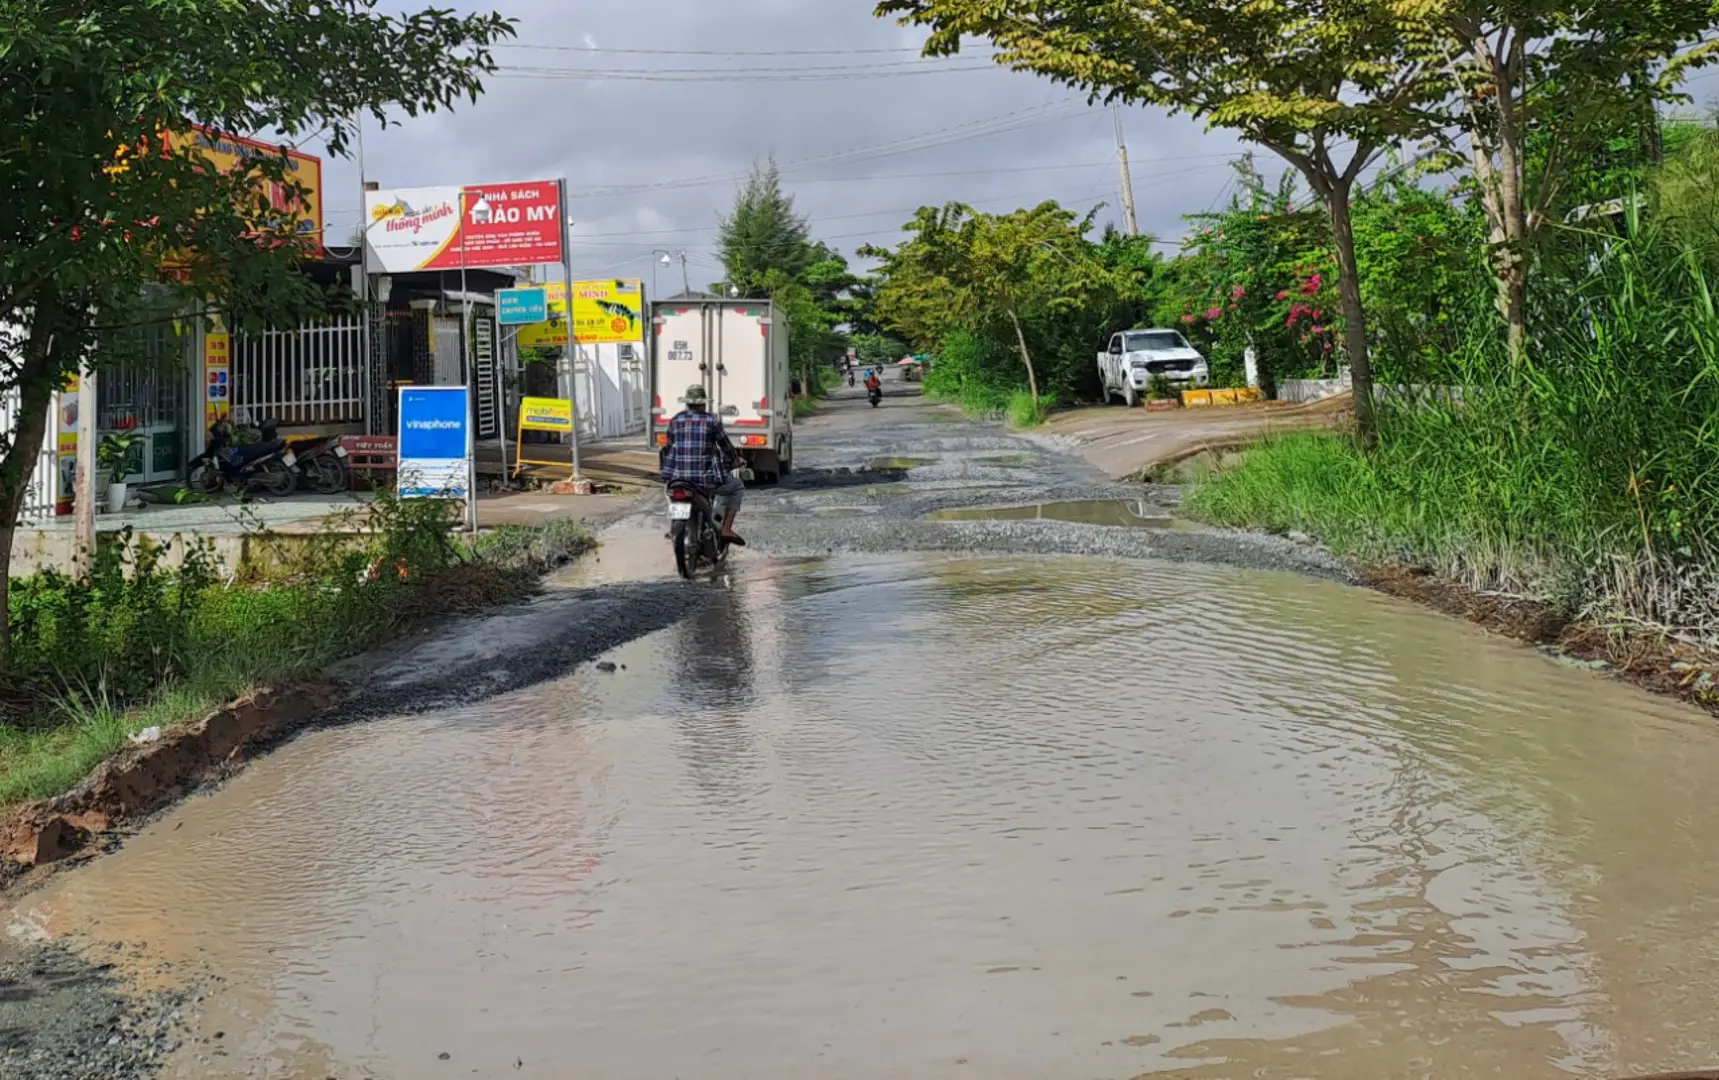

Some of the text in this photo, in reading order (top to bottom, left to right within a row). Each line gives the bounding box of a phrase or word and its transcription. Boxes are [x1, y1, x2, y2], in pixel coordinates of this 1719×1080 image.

[484, 188, 540, 201] NHÀ SÁCH
[526, 205, 556, 222] MY
[406, 417, 462, 431] vinaphone
